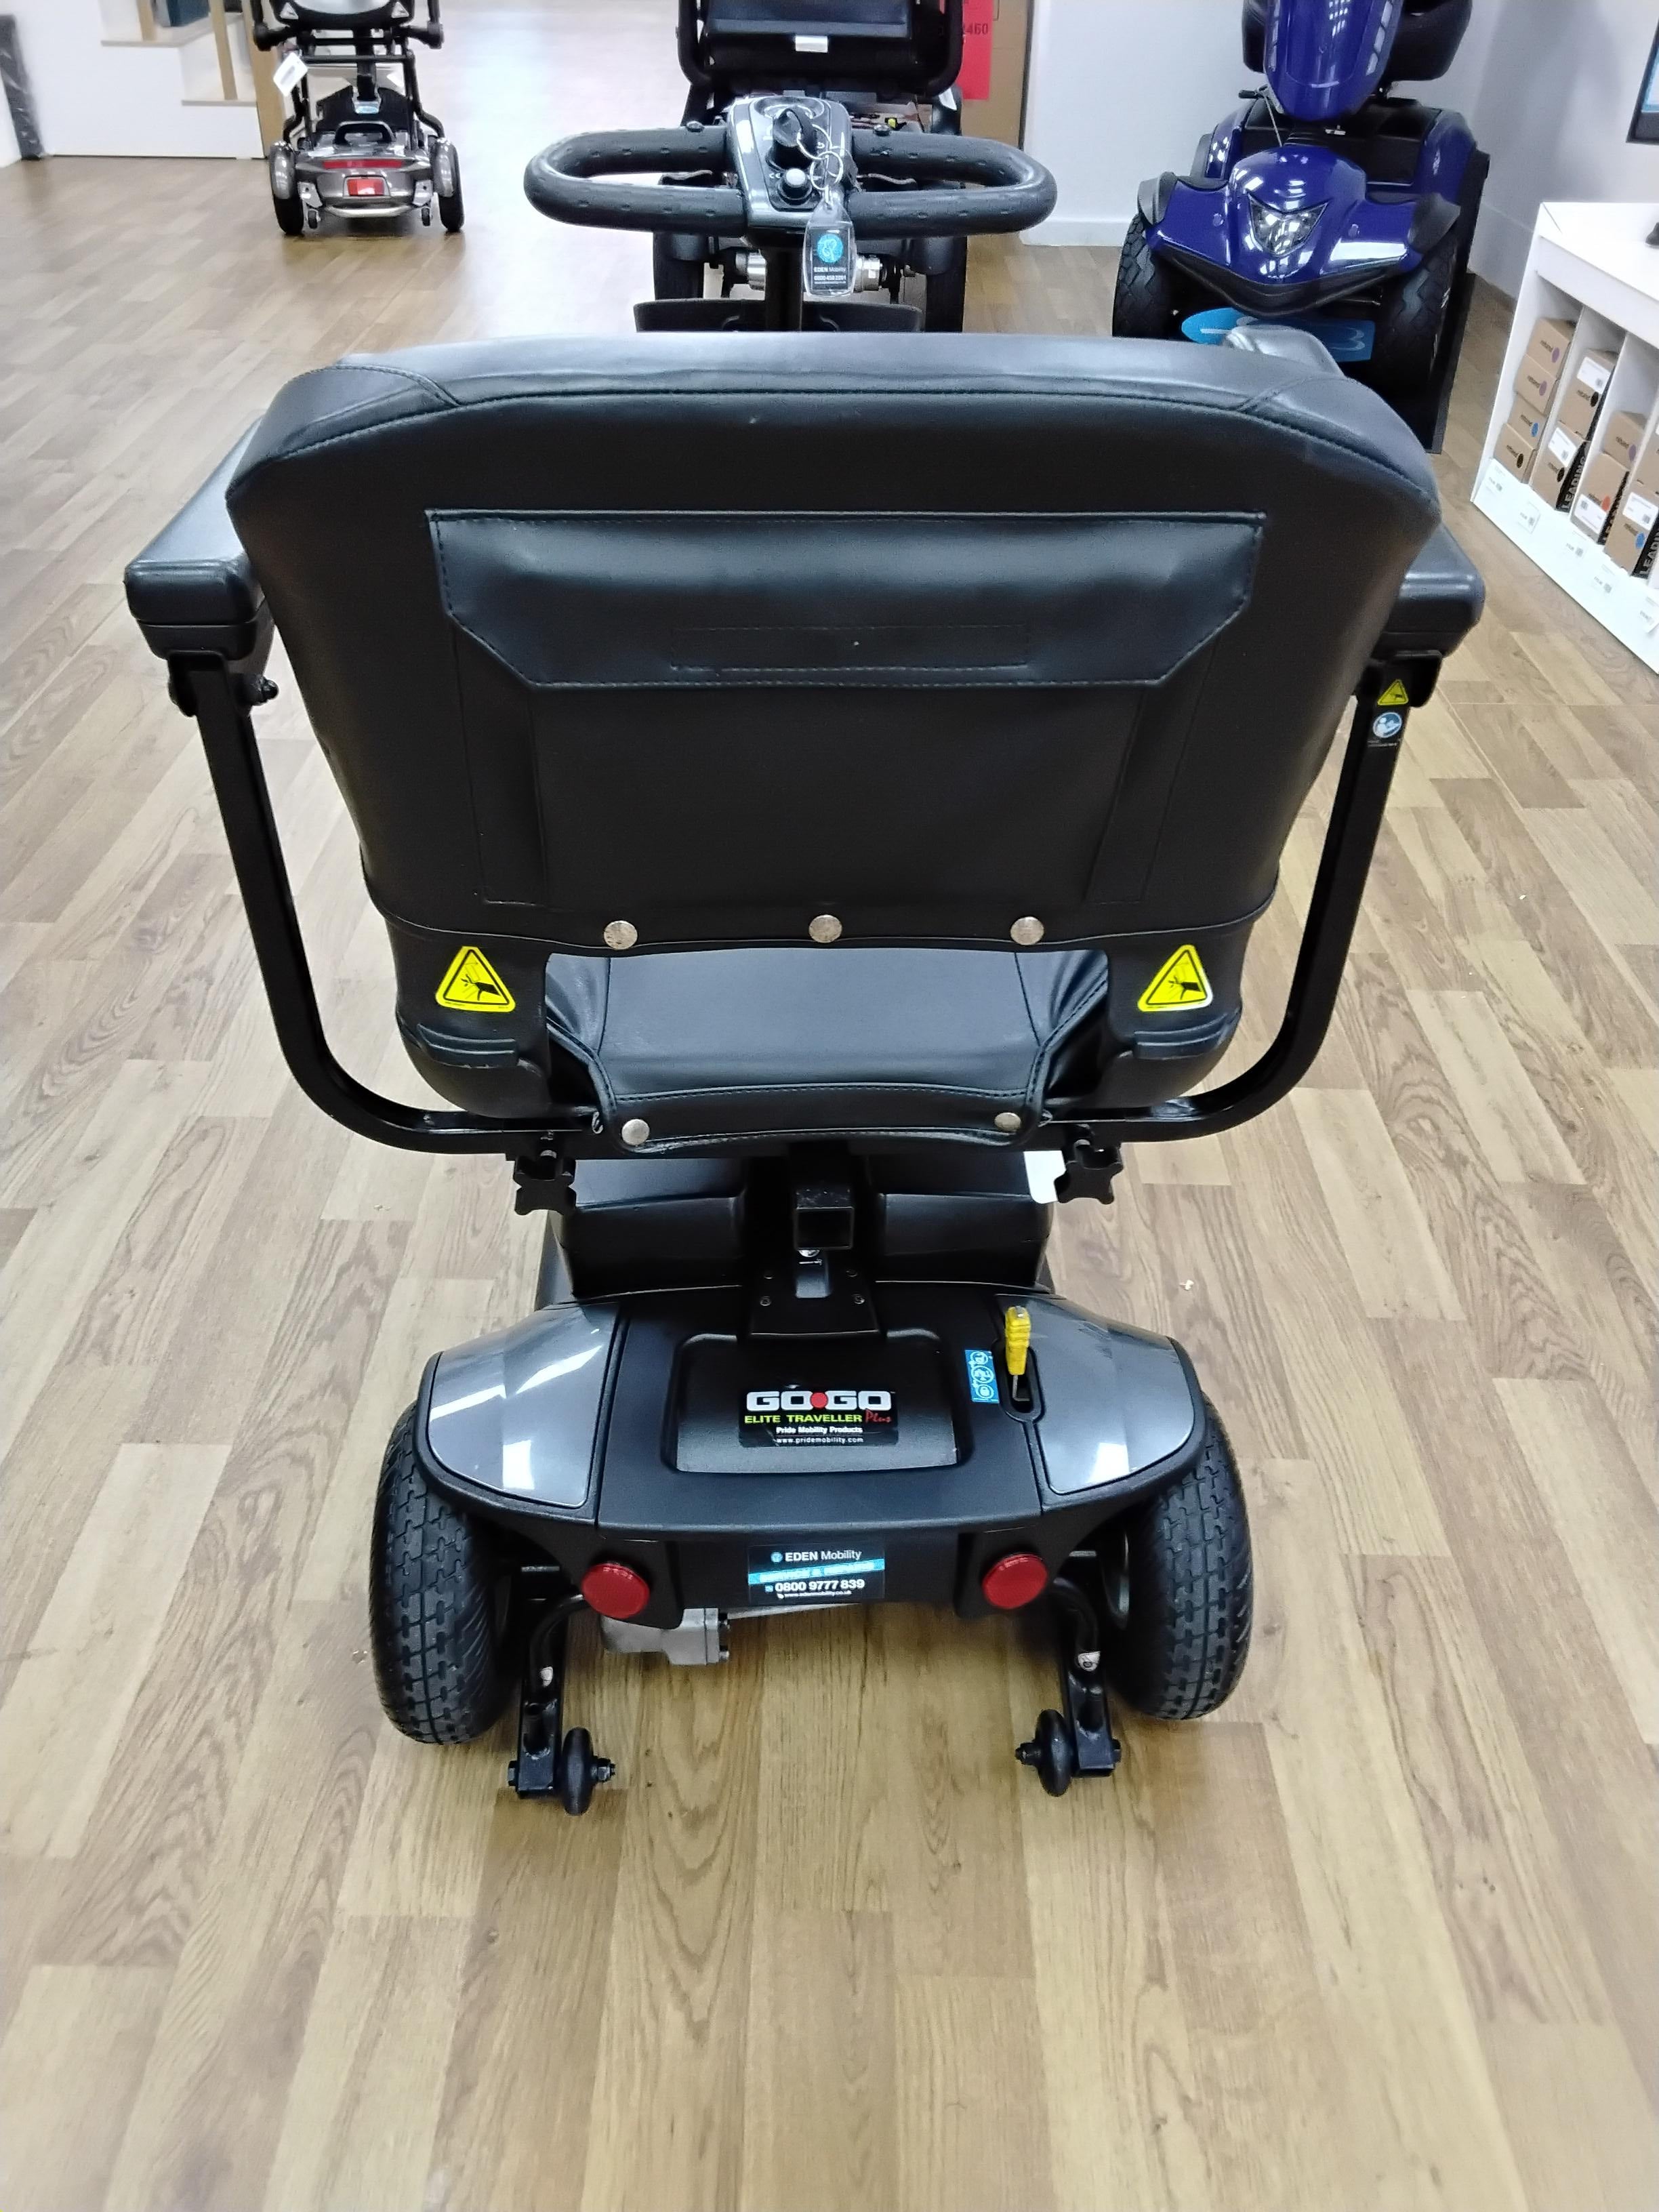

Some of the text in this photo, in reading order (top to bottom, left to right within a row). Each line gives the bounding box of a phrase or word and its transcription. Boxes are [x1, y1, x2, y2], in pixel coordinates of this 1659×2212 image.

[744, 1409, 892, 1424] ELITE TRAVELLER Plus
[798, 1426, 828, 1435] Mobility
[785, 1549, 863, 1562] EDEN Mobility
[775, 1578, 865, 1592] 0800 9777 839
